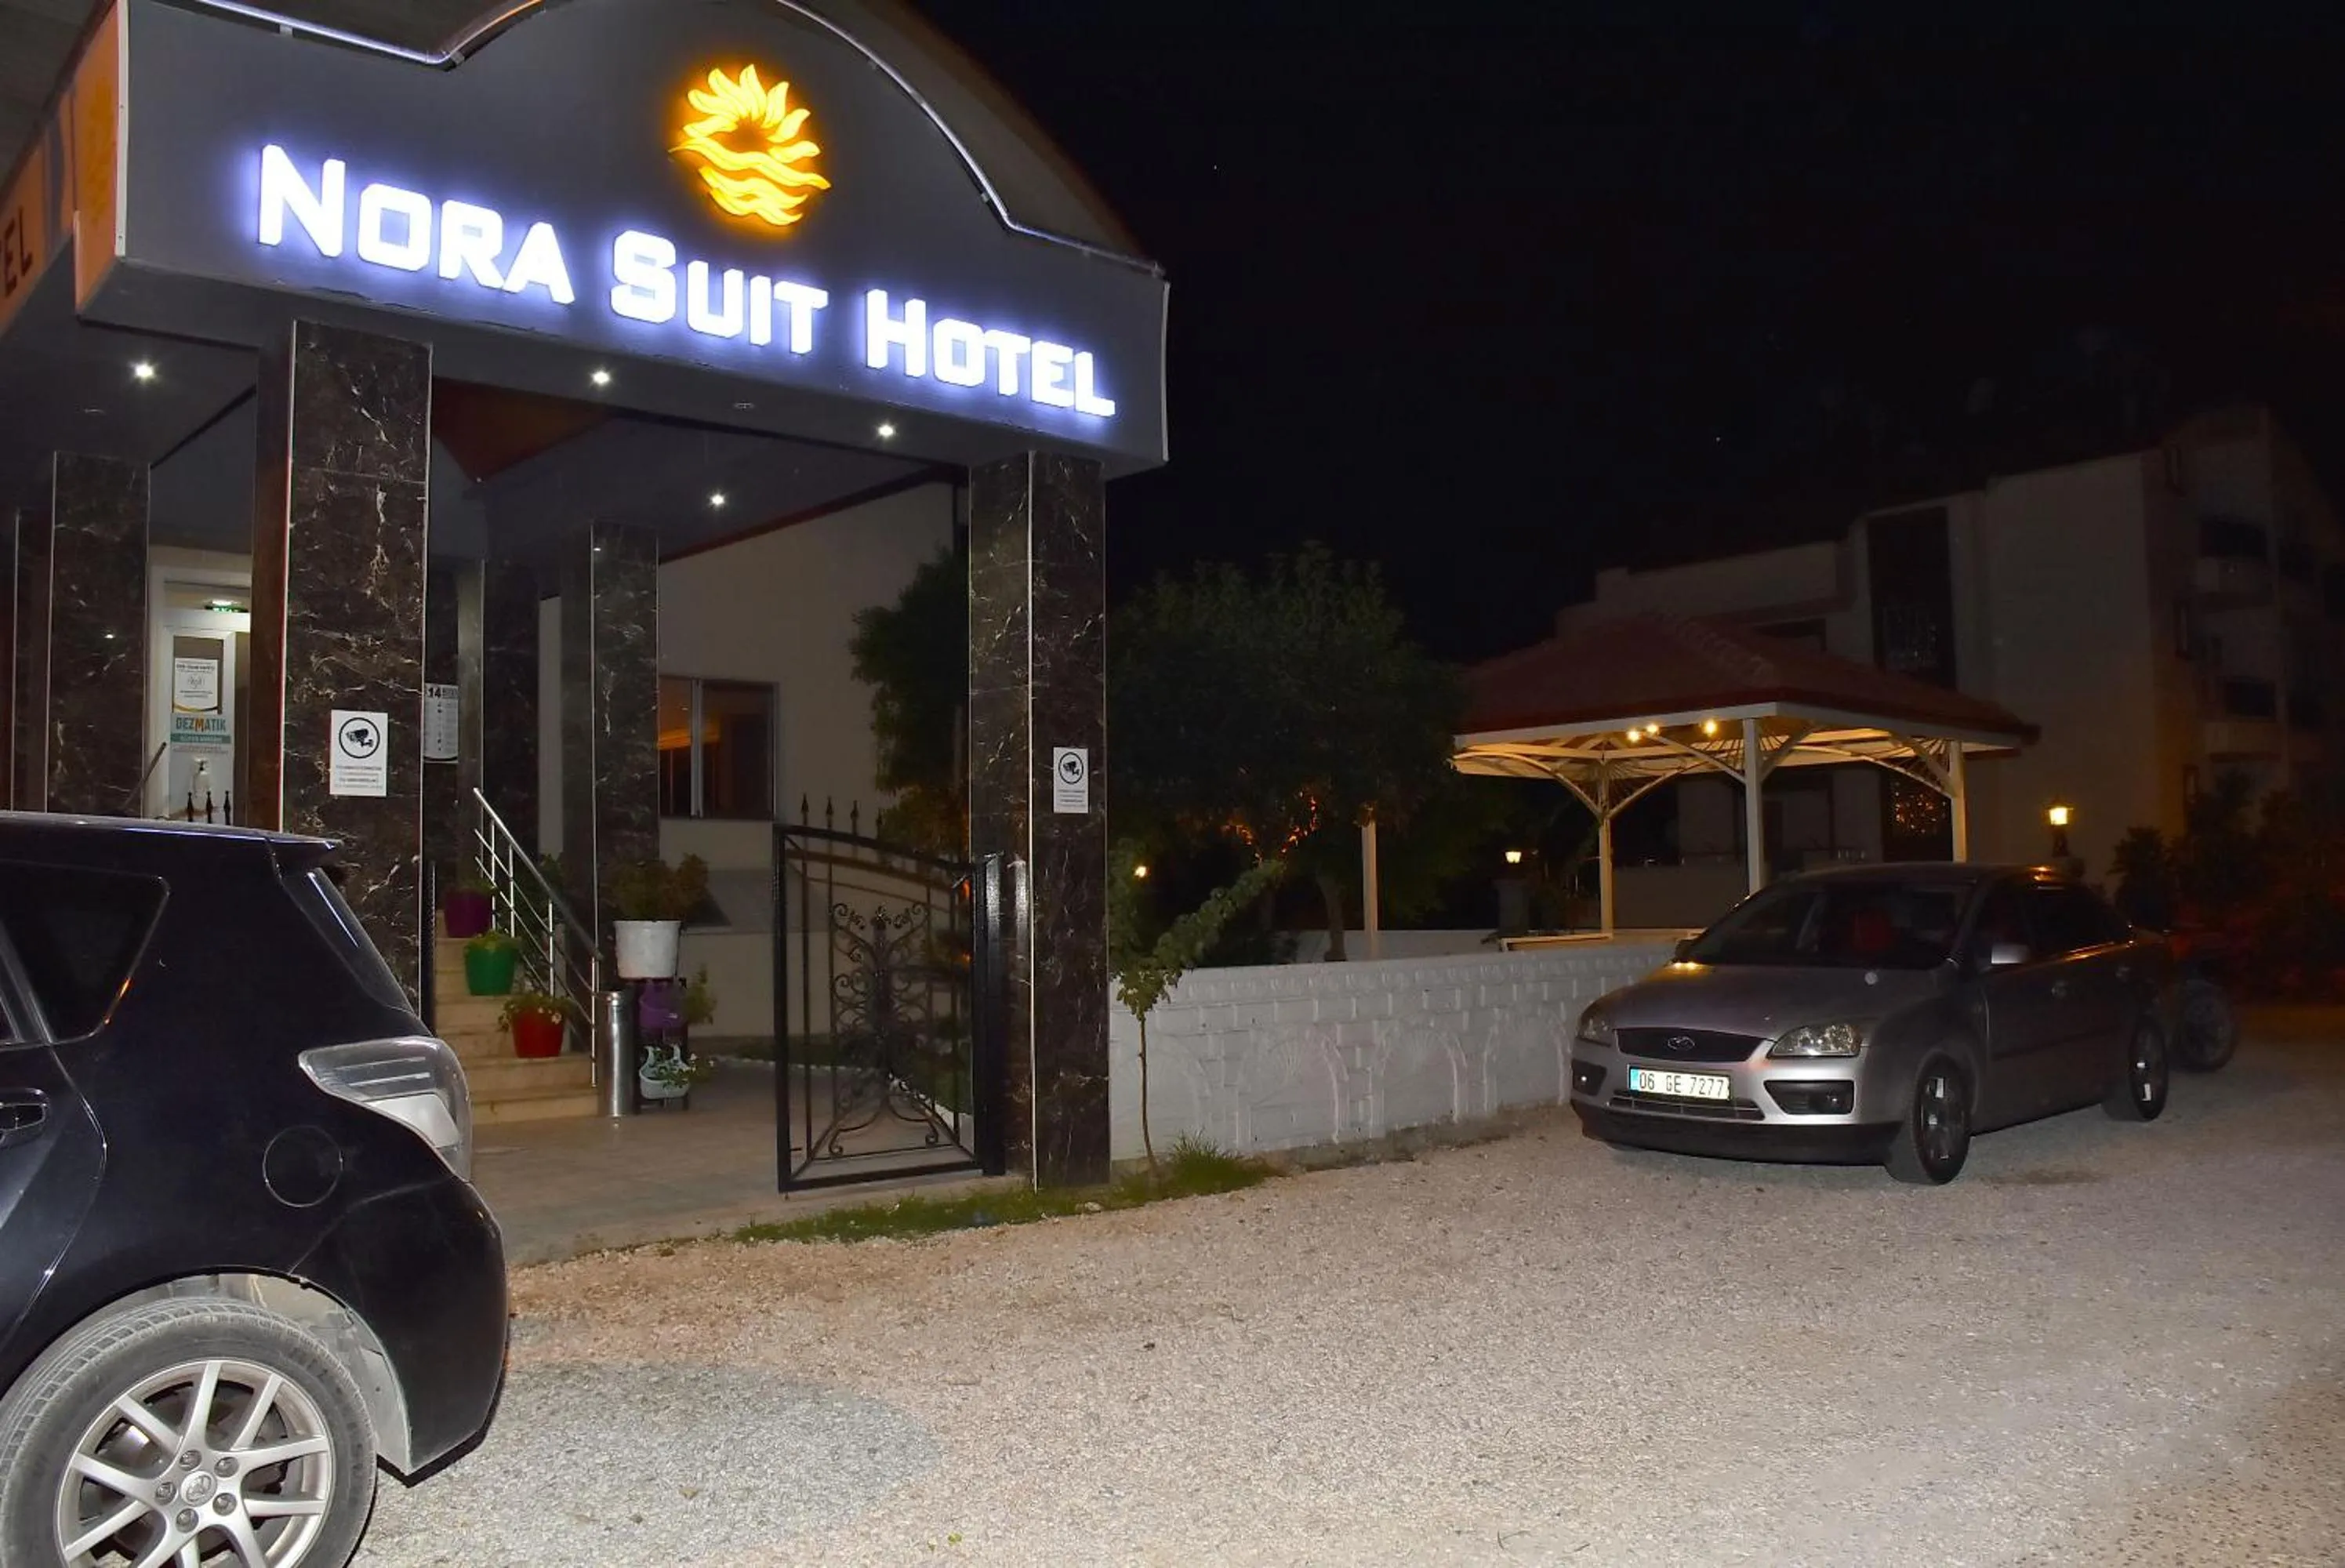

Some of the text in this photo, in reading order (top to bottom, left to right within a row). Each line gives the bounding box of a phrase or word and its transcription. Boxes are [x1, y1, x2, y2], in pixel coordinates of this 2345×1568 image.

[0, 206, 33, 298] EL
[259, 144, 1117, 418] NORA SUIT HOTEL
[176, 717, 227, 731] DEZMATIK
[1639, 1072, 1725, 1097] 06 GE 7277
